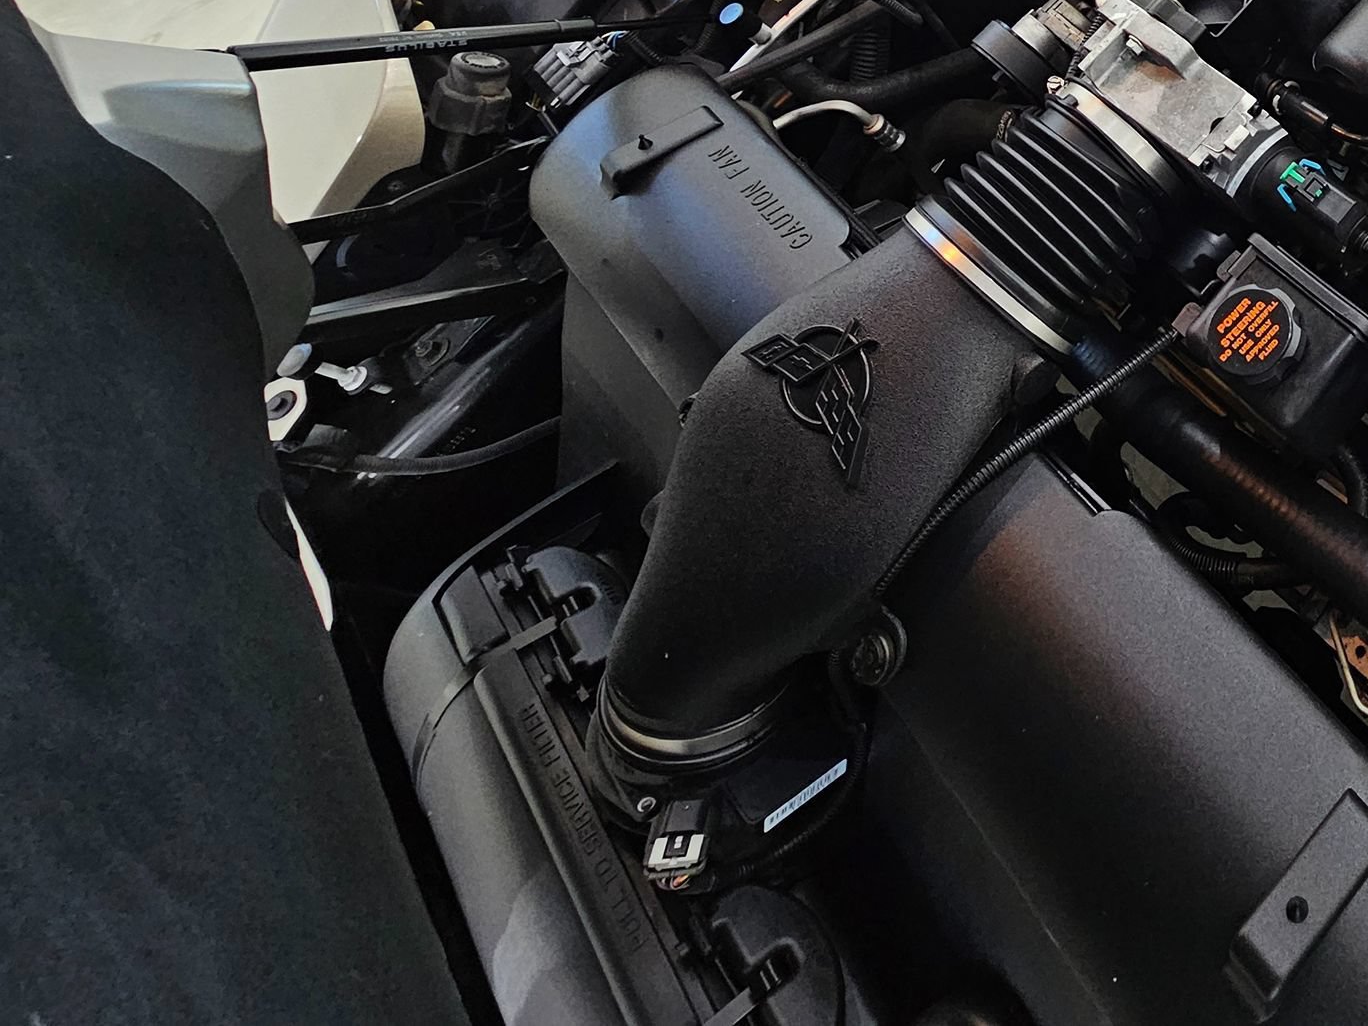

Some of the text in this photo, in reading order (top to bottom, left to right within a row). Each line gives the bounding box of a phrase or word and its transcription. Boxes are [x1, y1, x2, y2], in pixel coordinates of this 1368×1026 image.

[708, 145, 813, 249] CAUTION FAN
[1216, 297, 1251, 334] POWER
[1219, 301, 1279, 362] DO NOT OVERFILL
[1220, 301, 1266, 348] STEERING
[1239, 319, 1272, 354] USE ONLY
[1246, 324, 1280, 362] APPROVED
[1259, 339, 1279, 361] FLUID
[522, 703, 649, 953] PULL TO SERVICE FILTER
